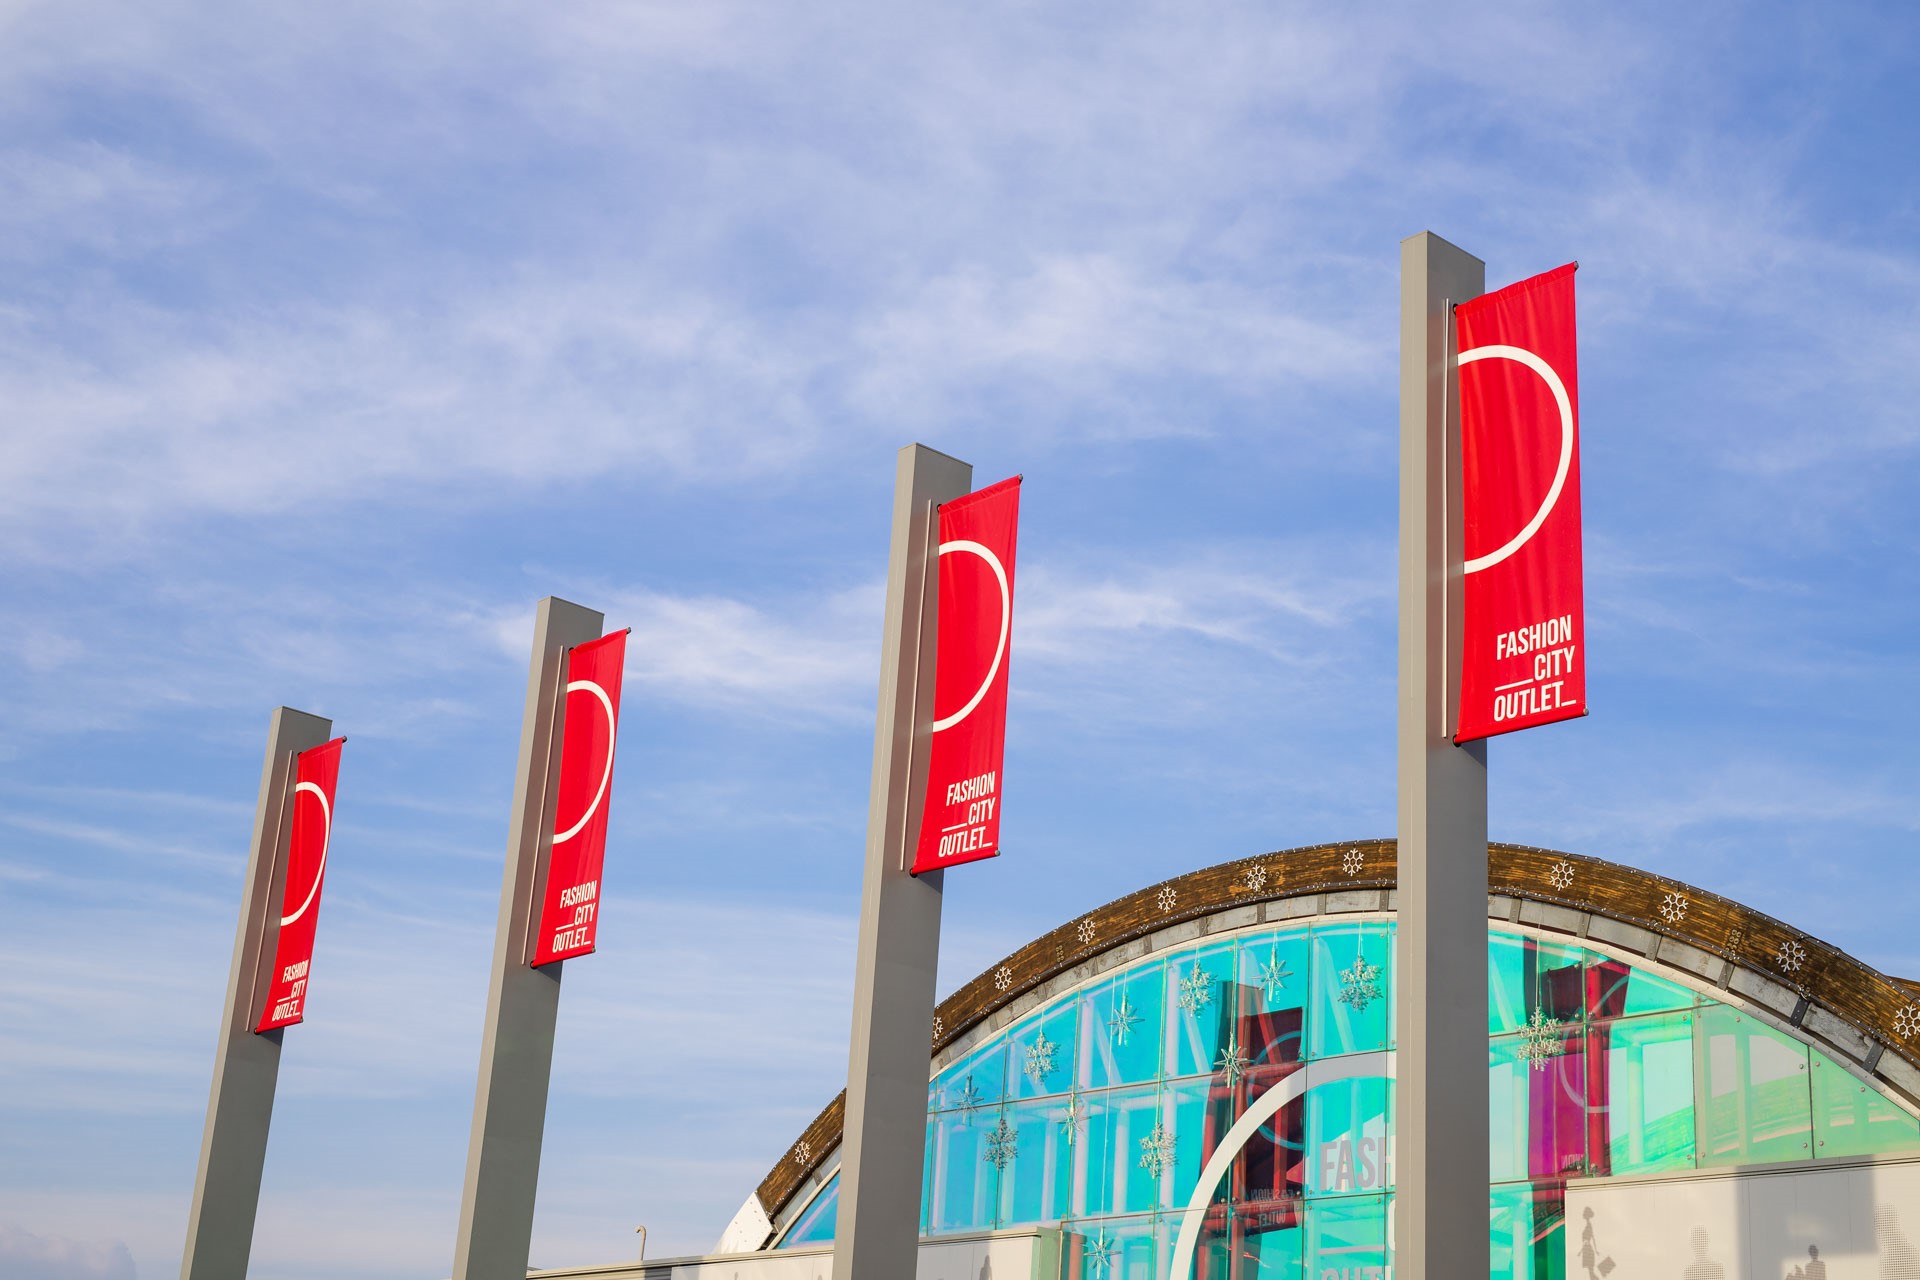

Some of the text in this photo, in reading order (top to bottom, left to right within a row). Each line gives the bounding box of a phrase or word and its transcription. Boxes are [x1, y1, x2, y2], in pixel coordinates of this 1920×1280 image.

[1496, 614, 1572, 661] FASHION
[946, 771, 996, 807] FASHION
[560, 880, 597, 909] FASHION
[282, 959, 309, 983] FASHION
[1320, 1135, 1396, 1193] FASH
